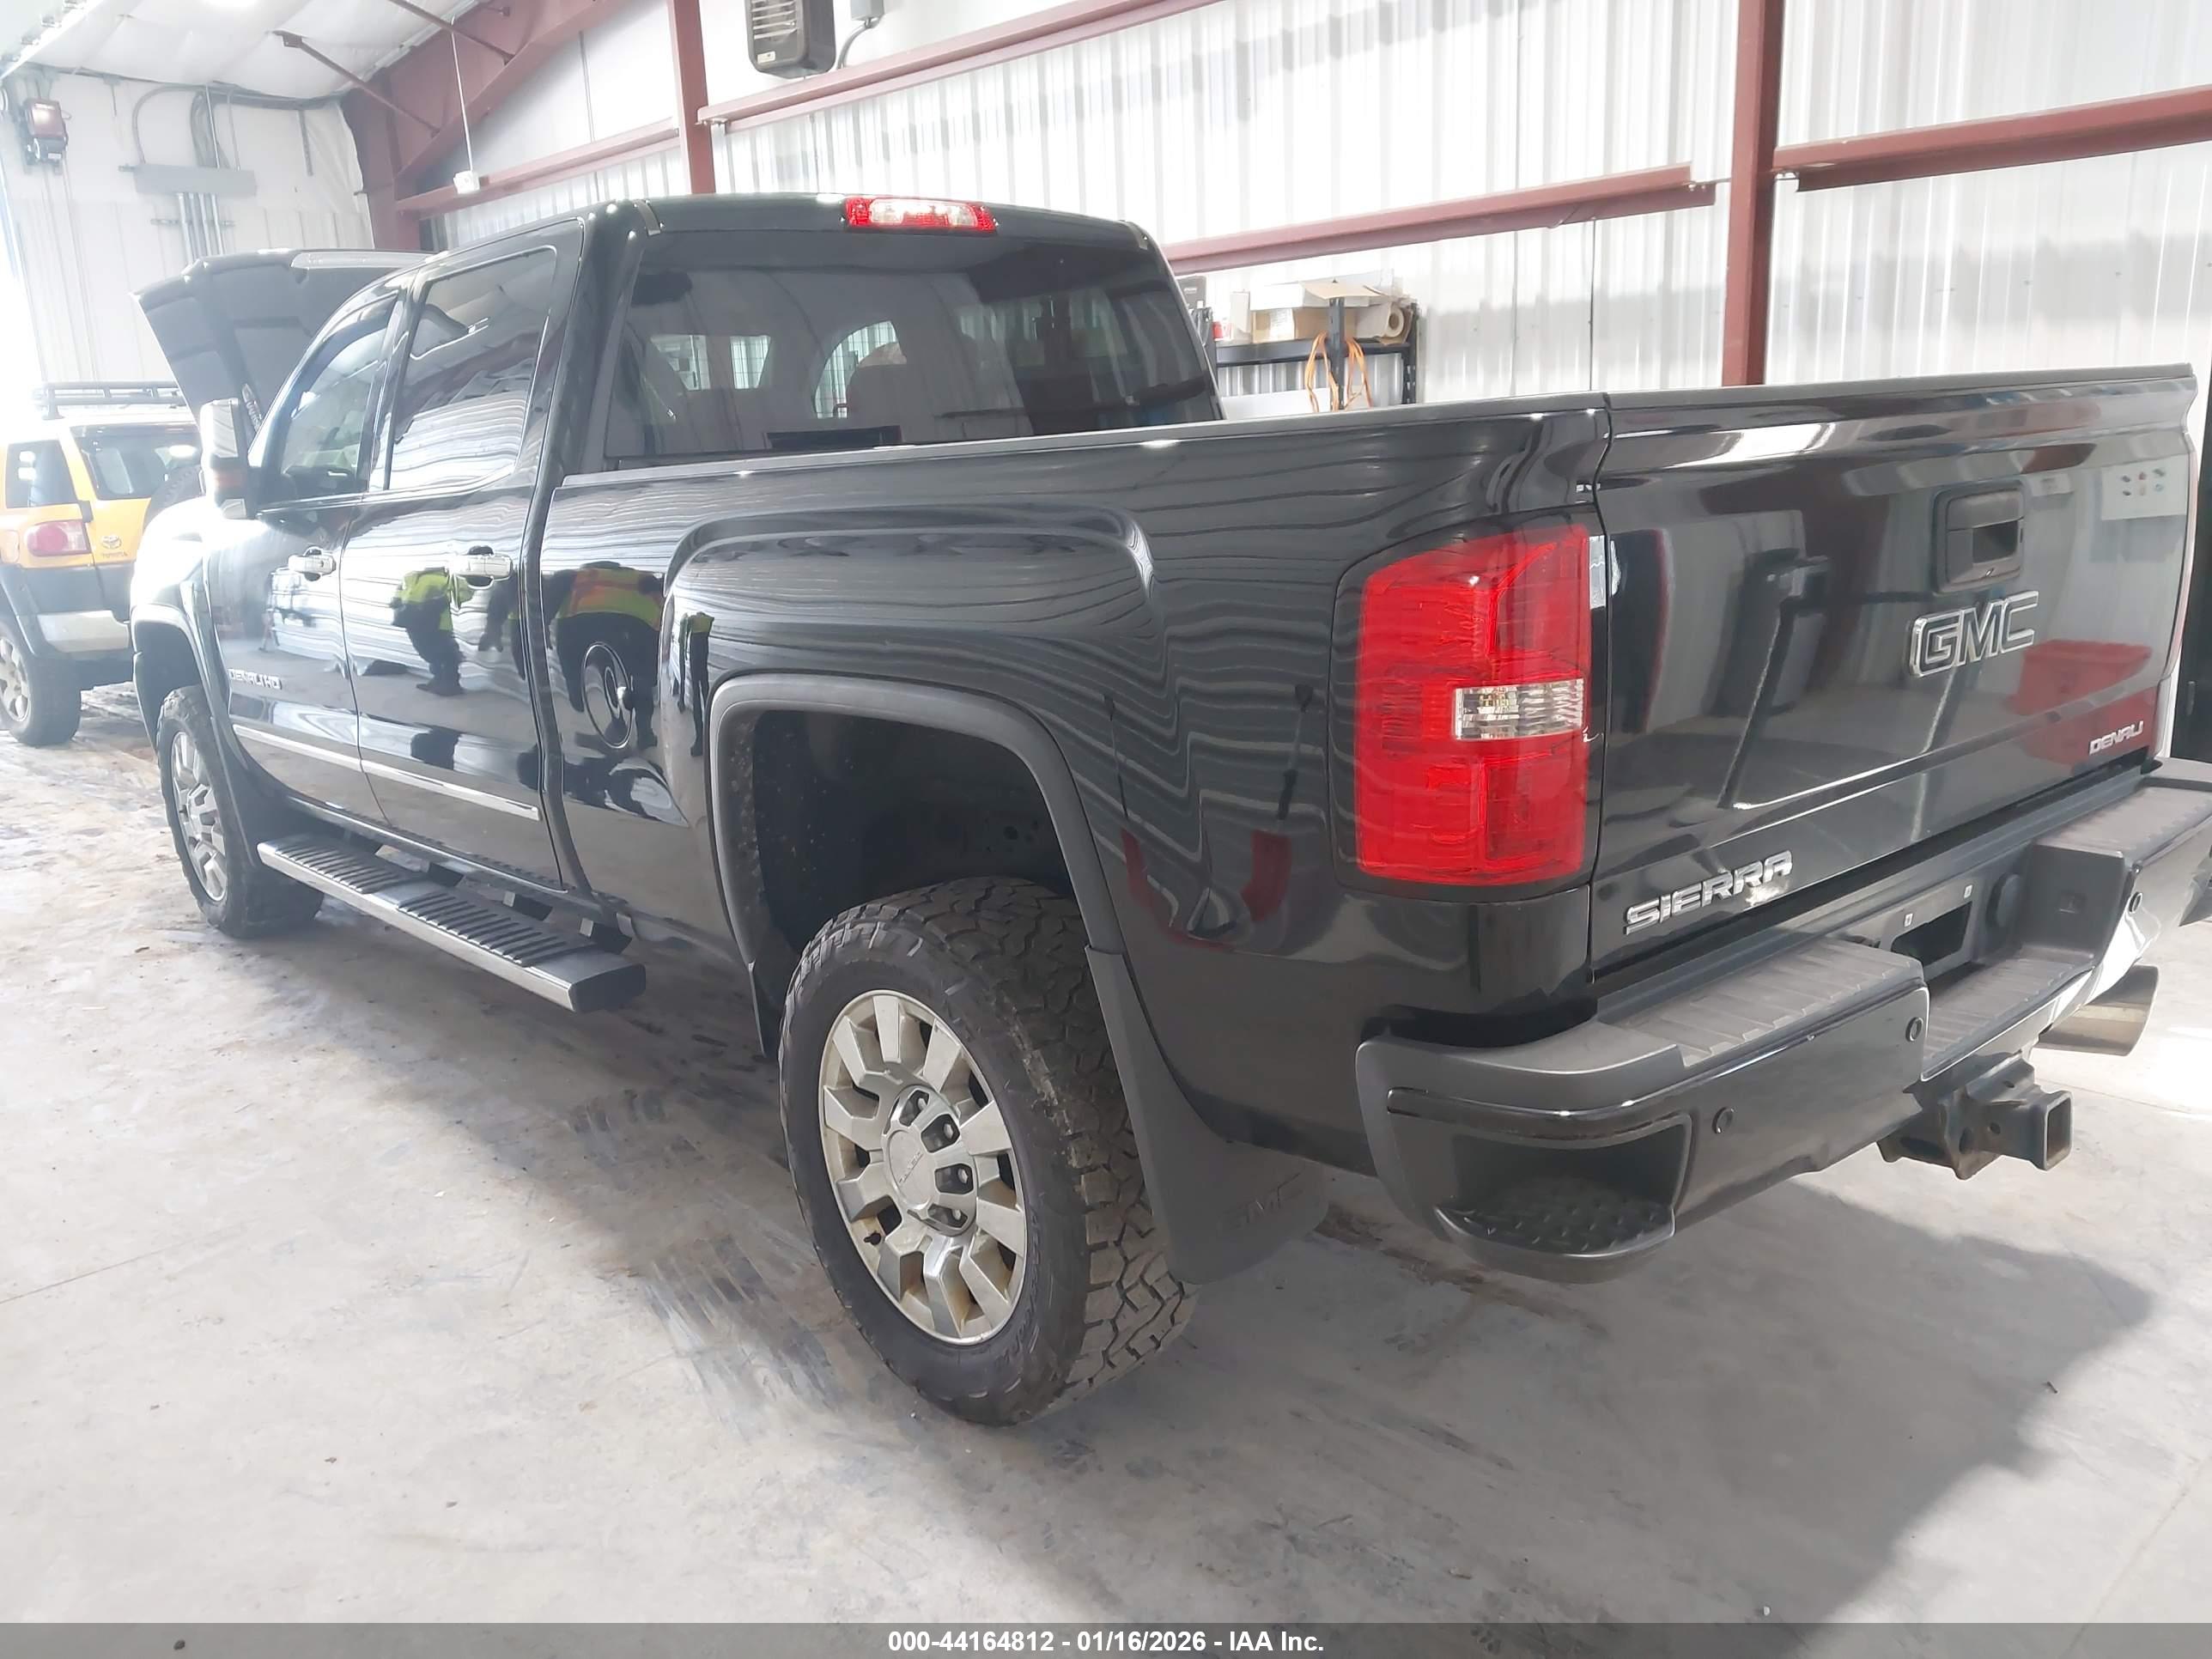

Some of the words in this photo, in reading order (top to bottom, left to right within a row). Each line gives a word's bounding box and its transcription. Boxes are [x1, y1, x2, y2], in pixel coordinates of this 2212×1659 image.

[1909, 590, 2039, 678] GMC
[2087, 720, 2144, 756] DENALI
[1624, 850, 1792, 935] SIERRA
